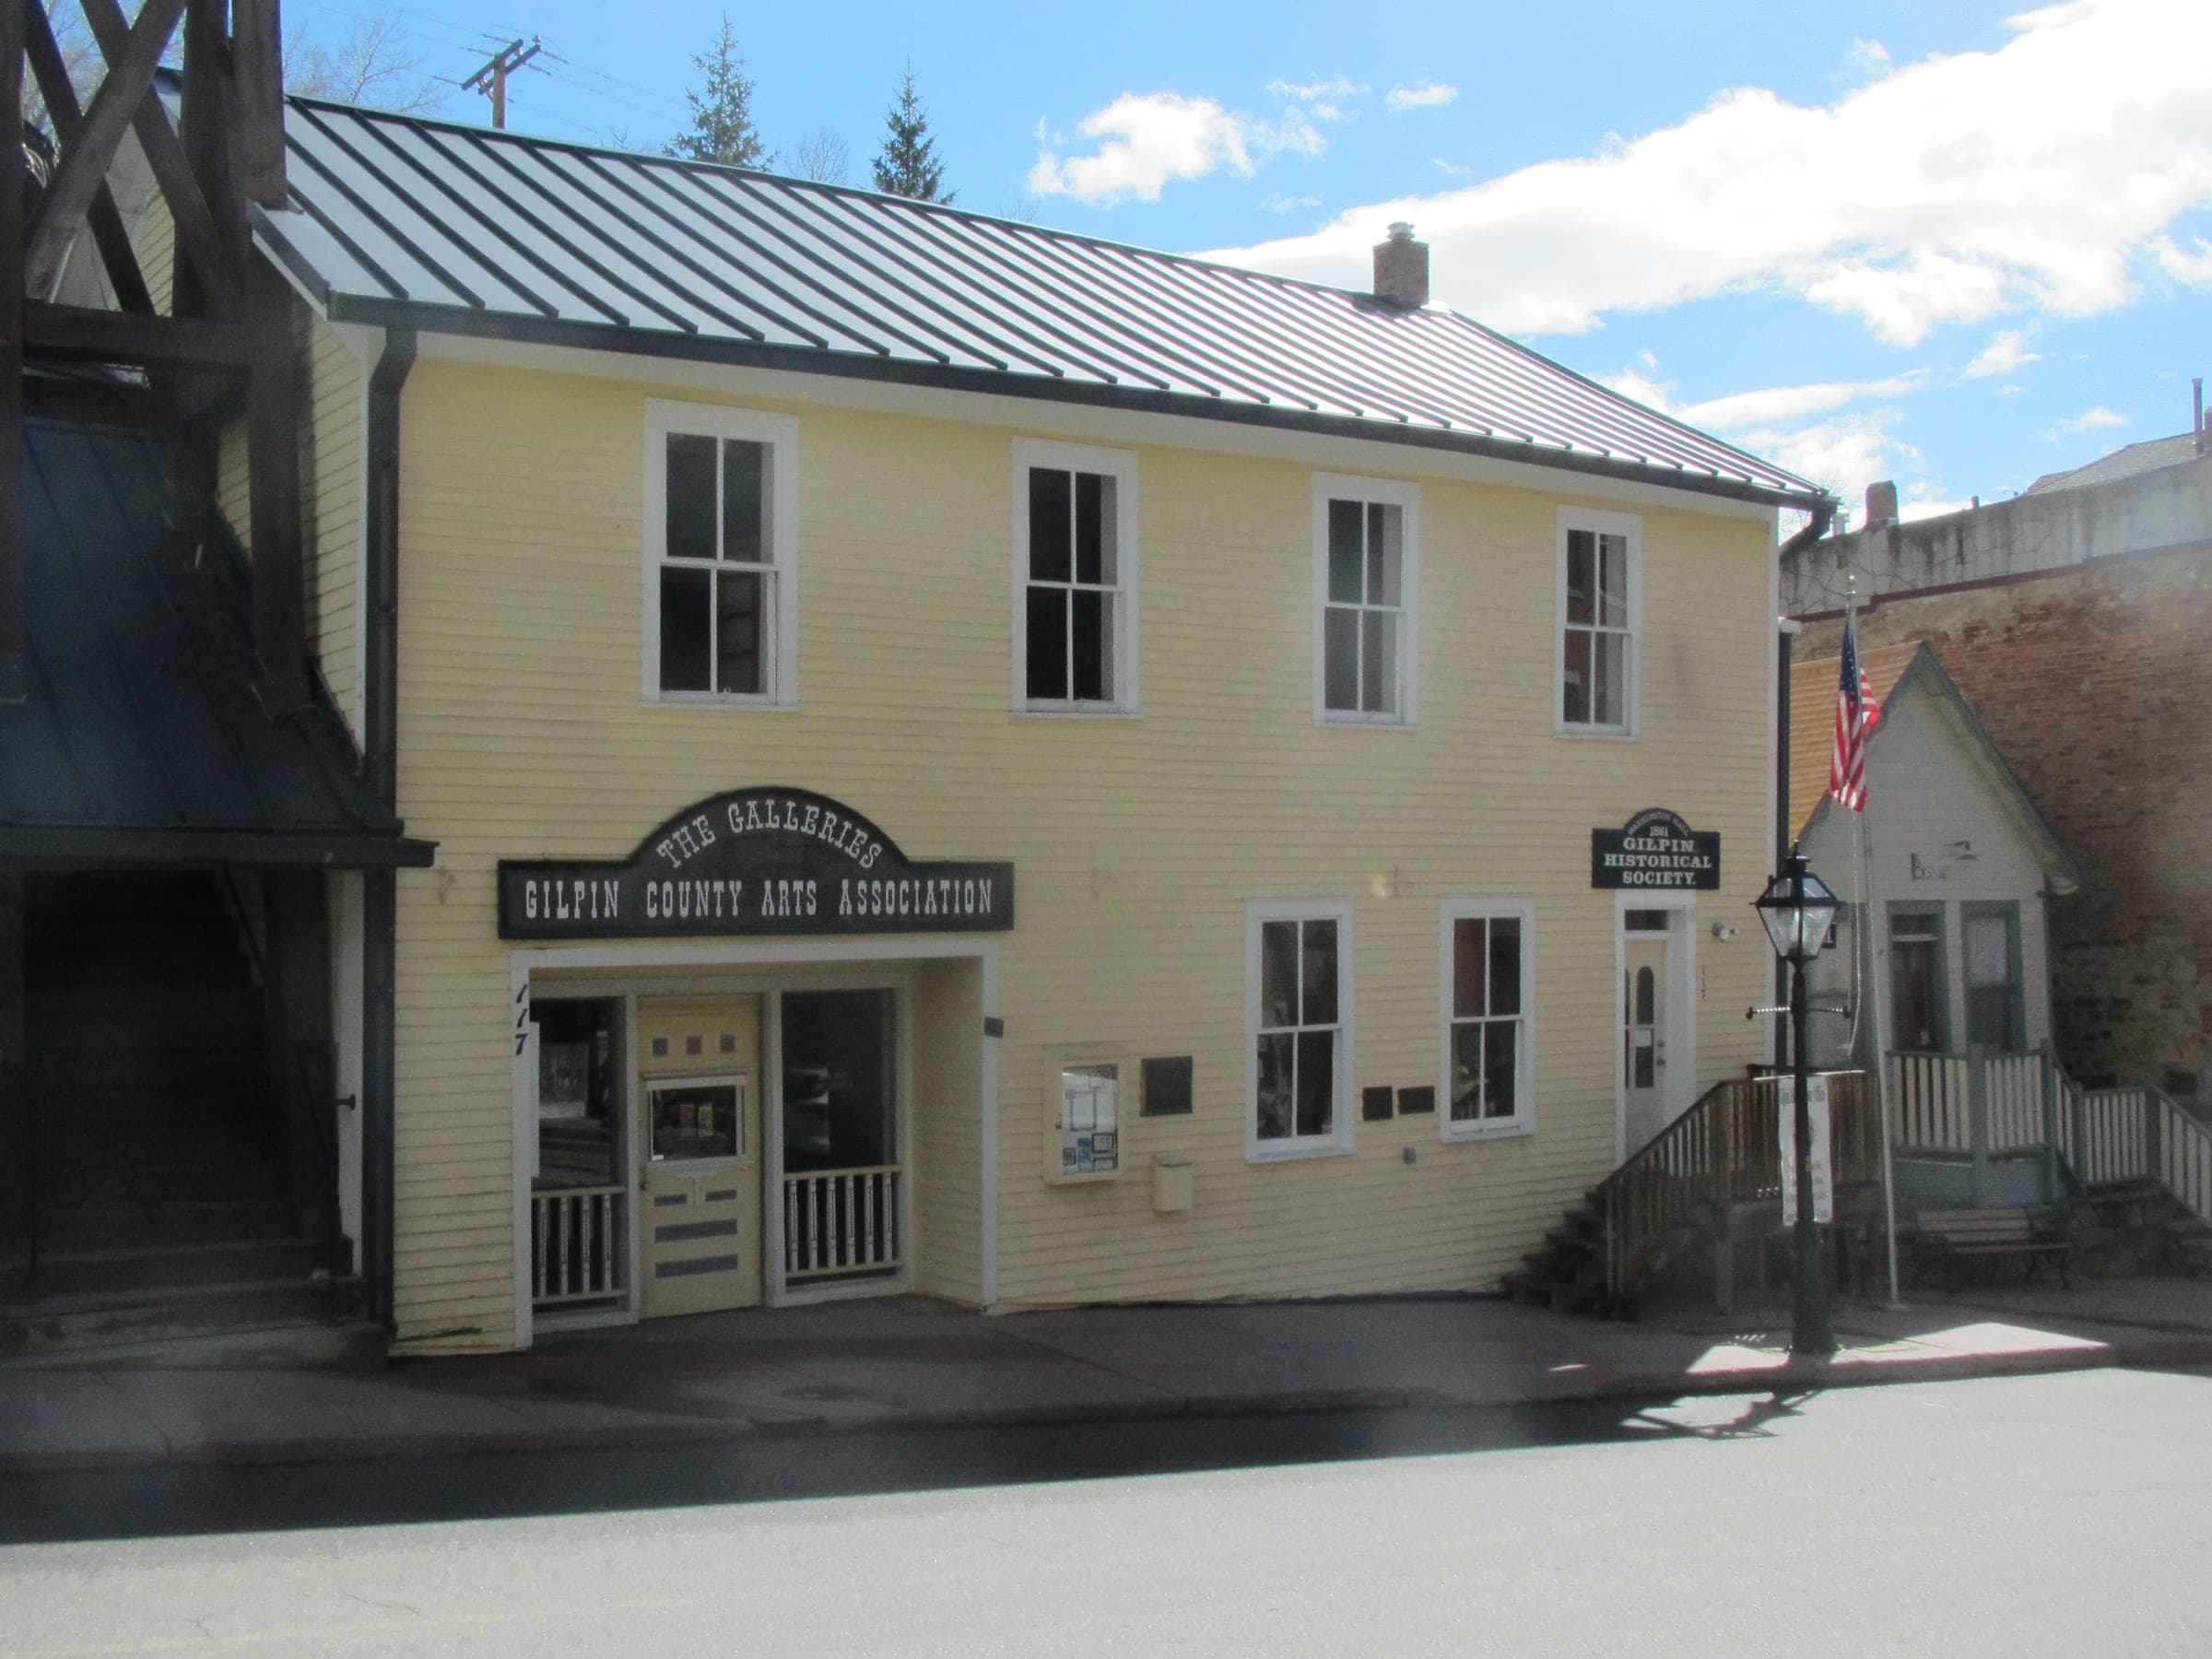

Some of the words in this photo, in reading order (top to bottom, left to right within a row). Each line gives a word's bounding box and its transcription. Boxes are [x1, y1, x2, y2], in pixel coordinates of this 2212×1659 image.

[657, 815, 717, 869] THE
[727, 798, 883, 869] GALLERIES
[1622, 837, 1695, 853] GILPIN
[1604, 853, 1712, 868] HISTORICAL
[524, 879, 619, 920] GILPIN
[646, 879, 742, 919] COUNTY
[760, 879, 818, 917] ARTS
[839, 878, 993, 916] ASSOCIATION
